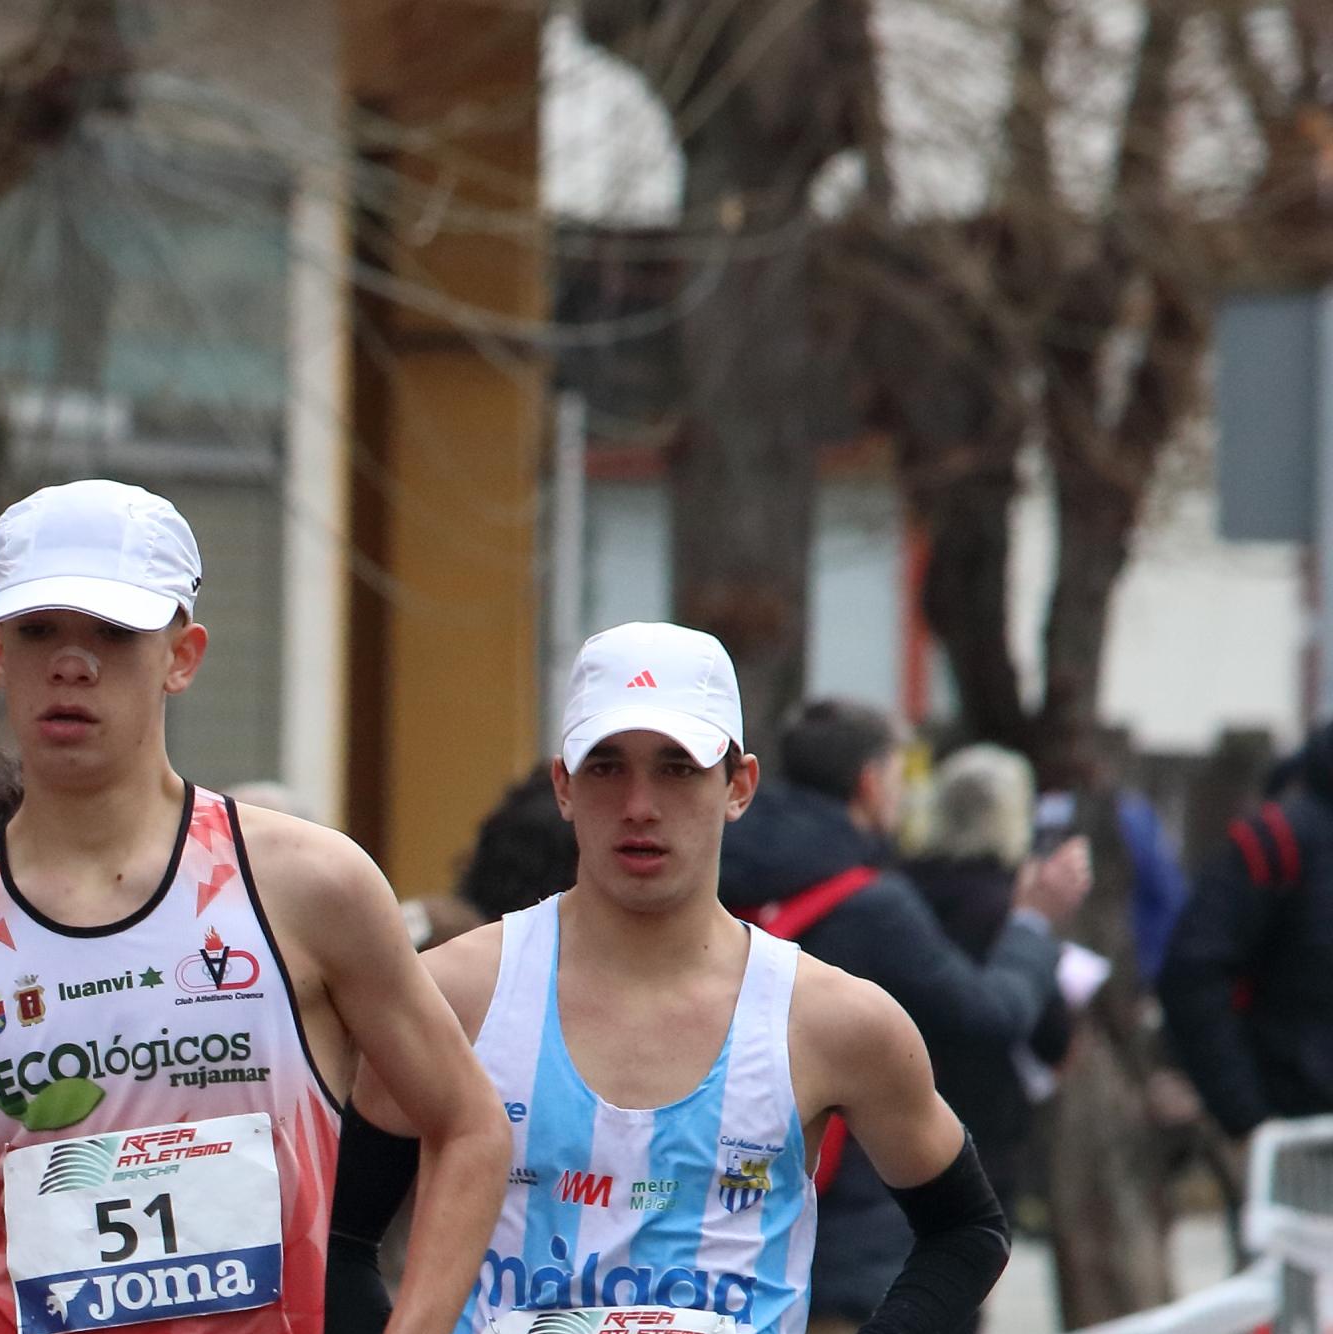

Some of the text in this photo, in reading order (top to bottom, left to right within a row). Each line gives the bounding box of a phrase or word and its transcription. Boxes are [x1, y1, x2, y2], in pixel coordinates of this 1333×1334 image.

[58, 971, 134, 1001] luanvi
[169, 1066, 271, 1089] rujamar
[122, 1128, 197, 1151] RFEA
[116, 1141, 234, 1168] ATLETISMO
[96, 1193, 178, 1263] 51
[604, 1312, 677, 1328] RFEA
